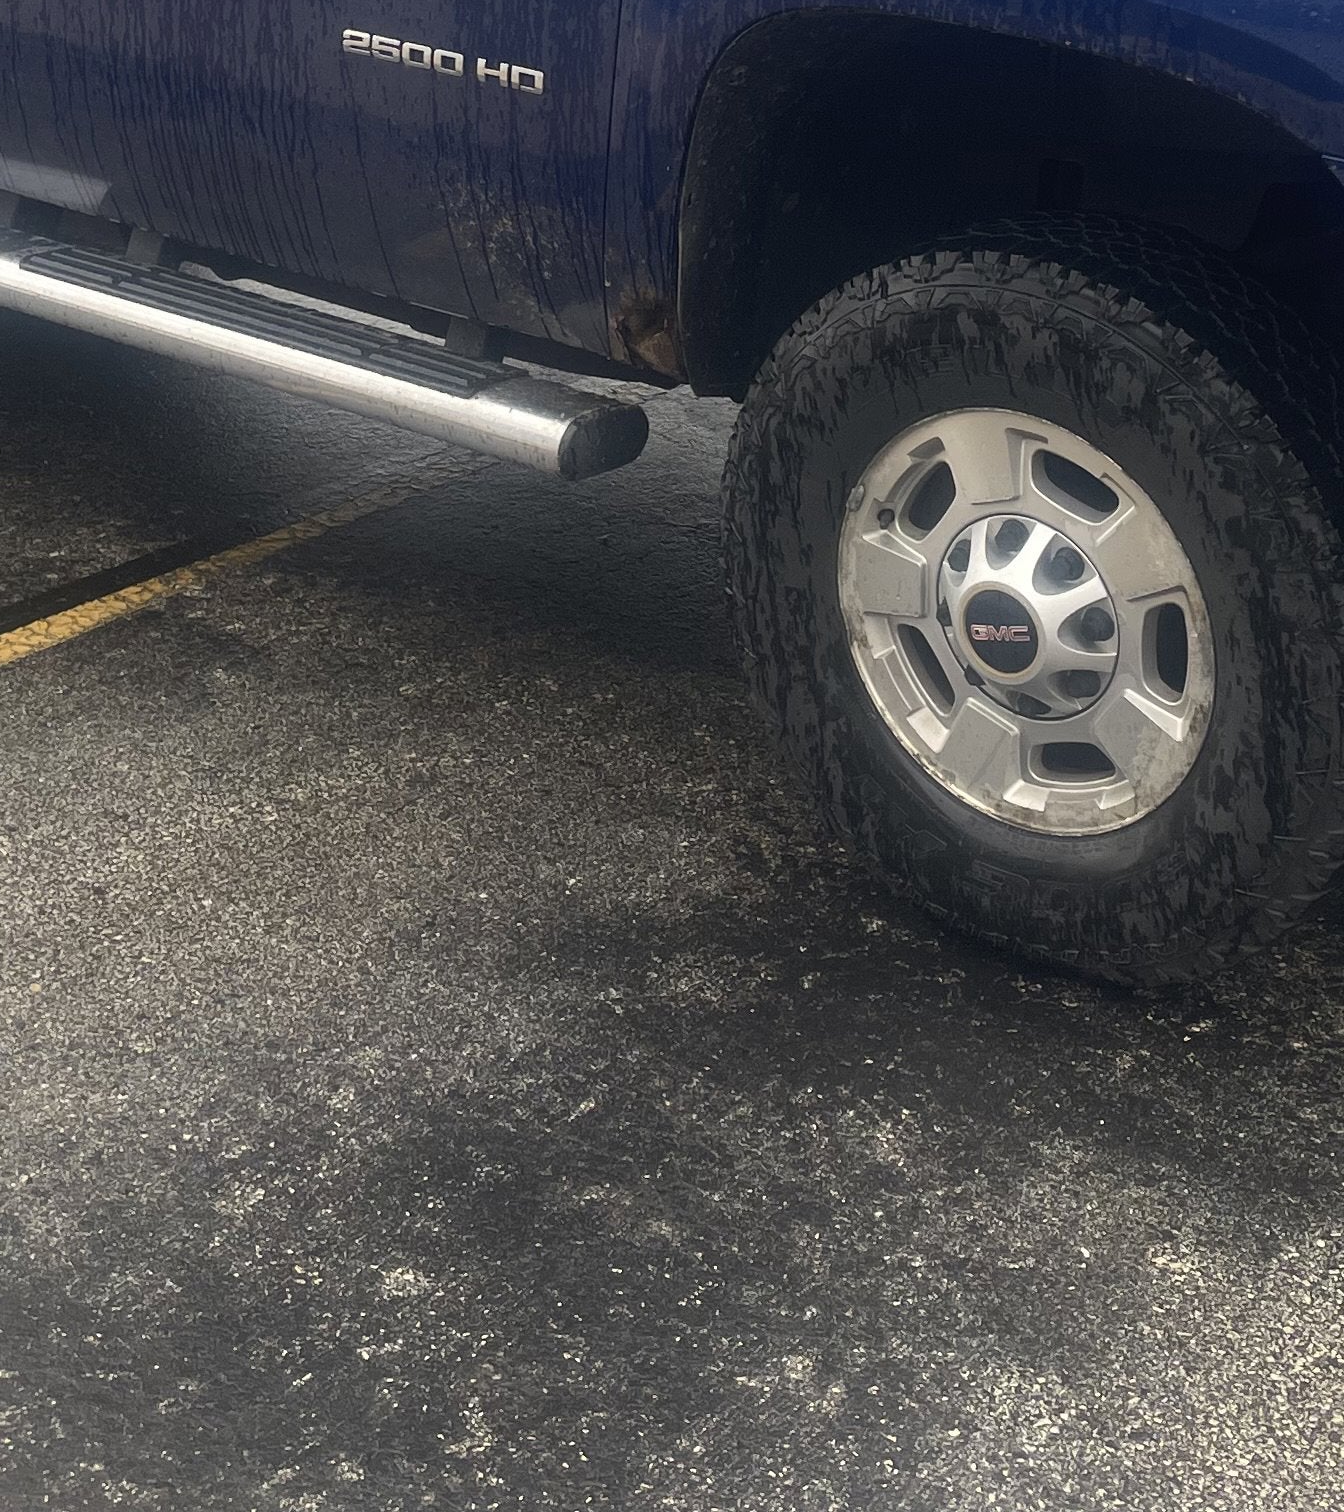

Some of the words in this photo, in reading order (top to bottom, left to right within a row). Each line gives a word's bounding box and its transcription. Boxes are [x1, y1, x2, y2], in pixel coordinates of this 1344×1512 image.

[342, 29, 464, 77] 2500
[476, 57, 544, 95] HD
[970, 624, 1031, 642] GMC
